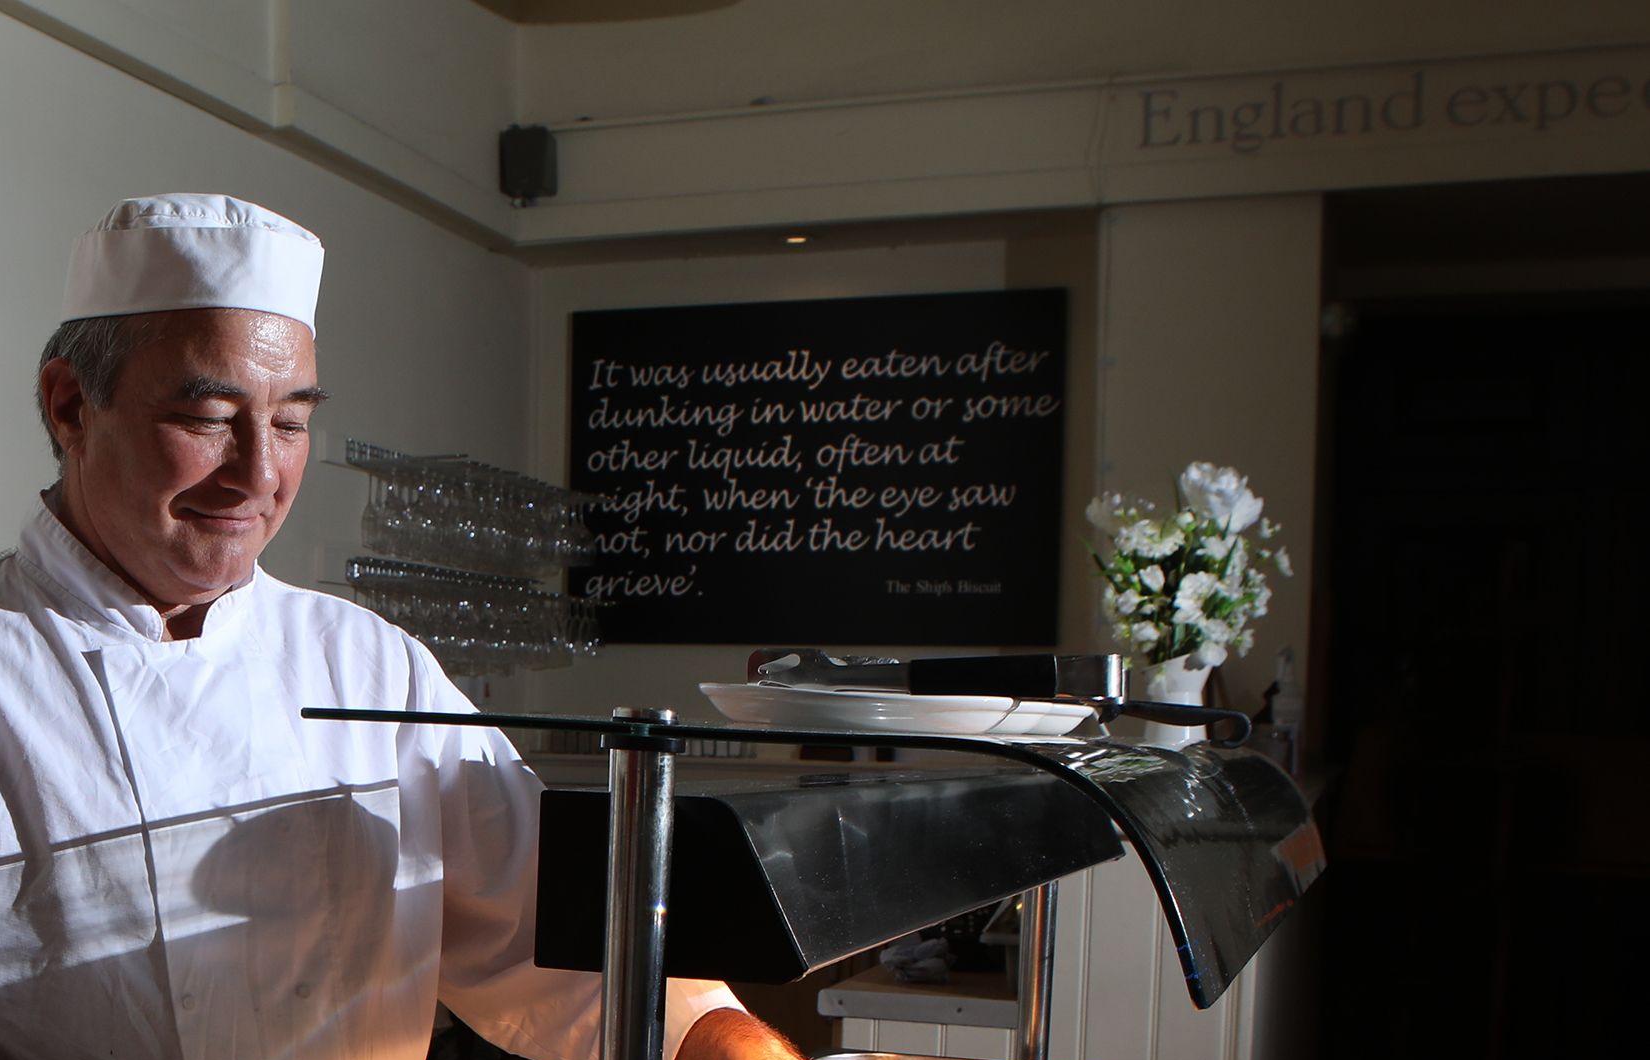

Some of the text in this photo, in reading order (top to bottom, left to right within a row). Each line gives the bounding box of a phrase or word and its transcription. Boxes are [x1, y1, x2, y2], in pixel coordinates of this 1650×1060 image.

[1136, 71, 1650, 154] England expe
[589, 340, 1050, 391] It was usually eaten after
[588, 392, 1062, 437] dunking in water or some
[587, 432, 967, 480] other liquid, often at
[703, 476, 801, 511] when
[880, 486, 943, 518] eye
[947, 482, 1017, 510] saw
[594, 517, 983, 561] not, nor did the heart
[885, 580, 912, 595] The
[957, 580, 1002, 595] Biscuit
